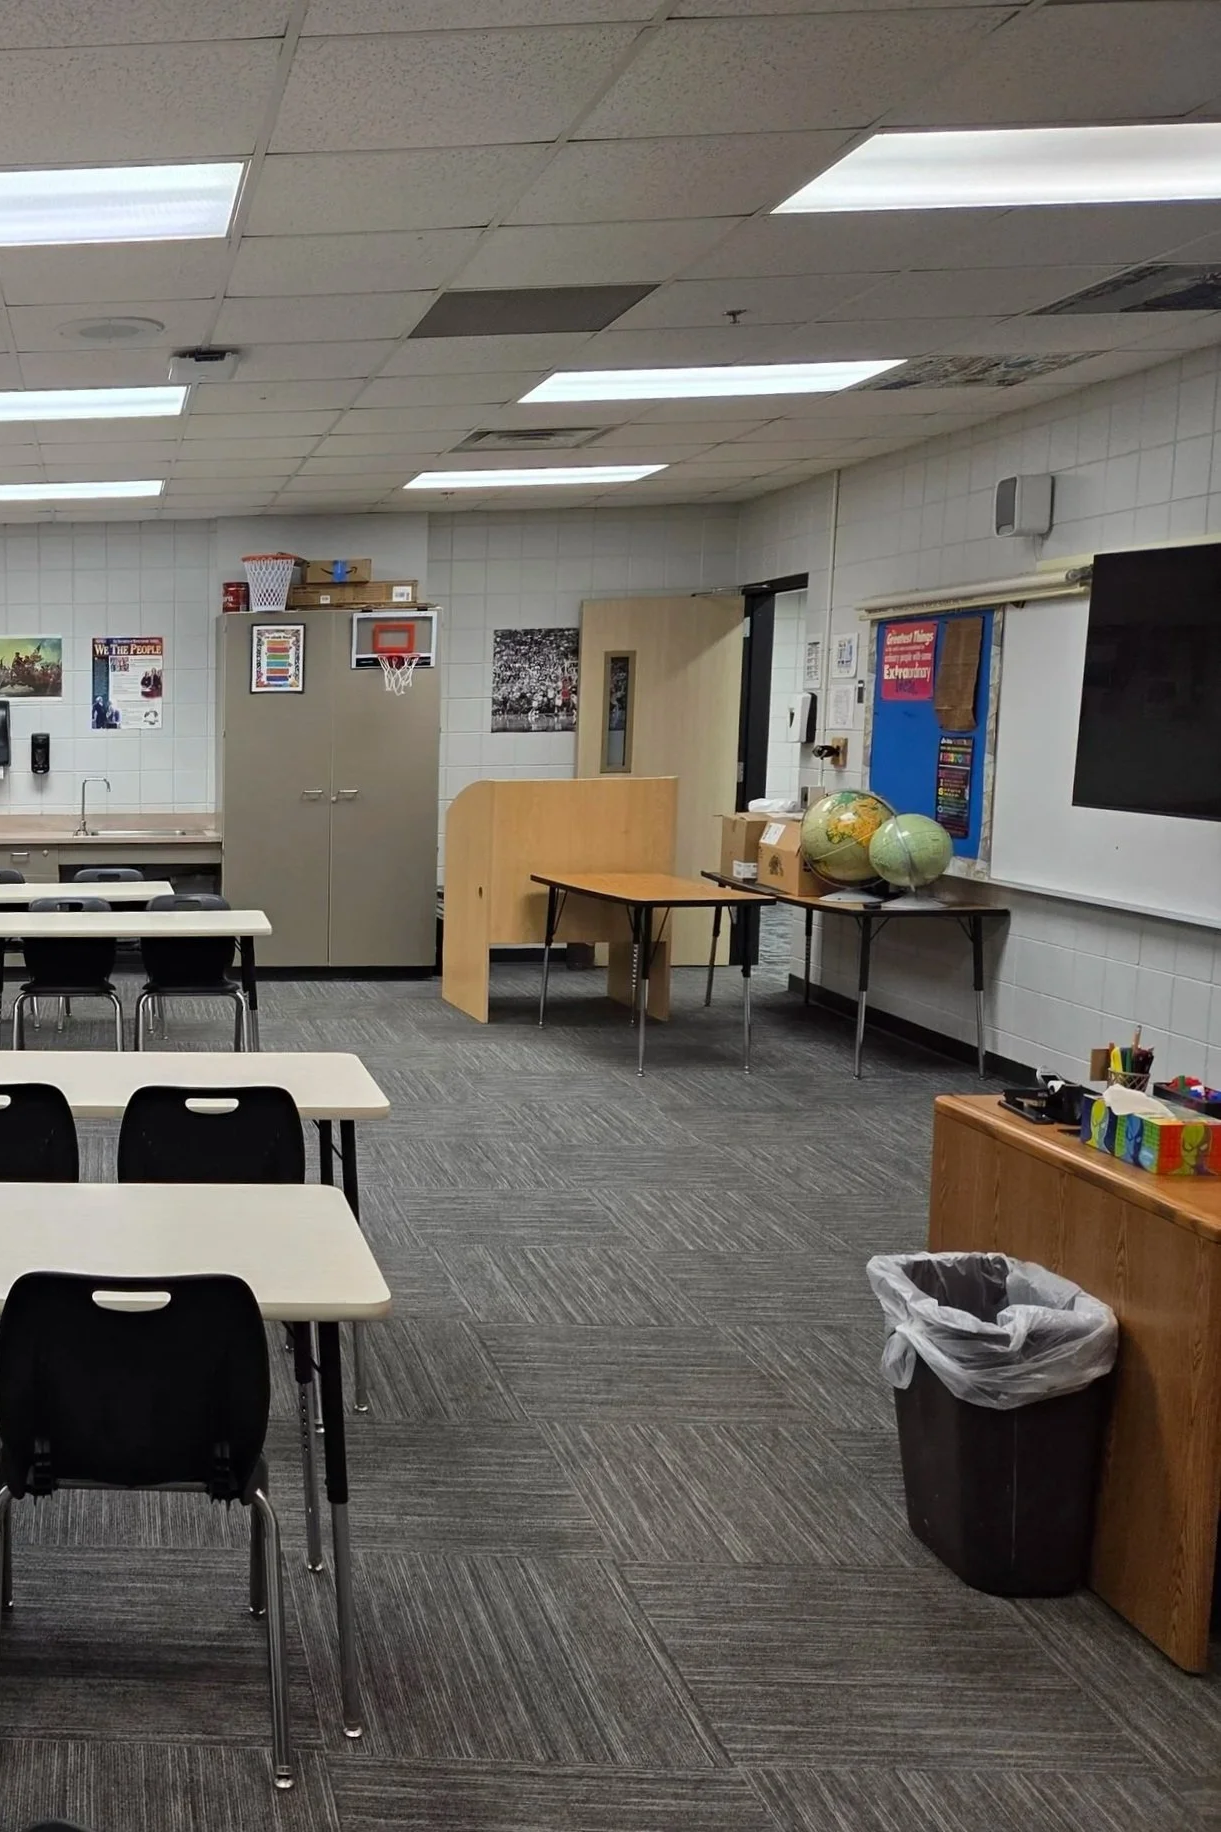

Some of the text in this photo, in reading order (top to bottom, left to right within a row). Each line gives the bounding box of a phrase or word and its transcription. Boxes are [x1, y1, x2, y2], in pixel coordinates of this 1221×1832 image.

[886, 629, 934, 646] Greatest Things
[94, 644, 161, 655] WE THE PEOPLE
